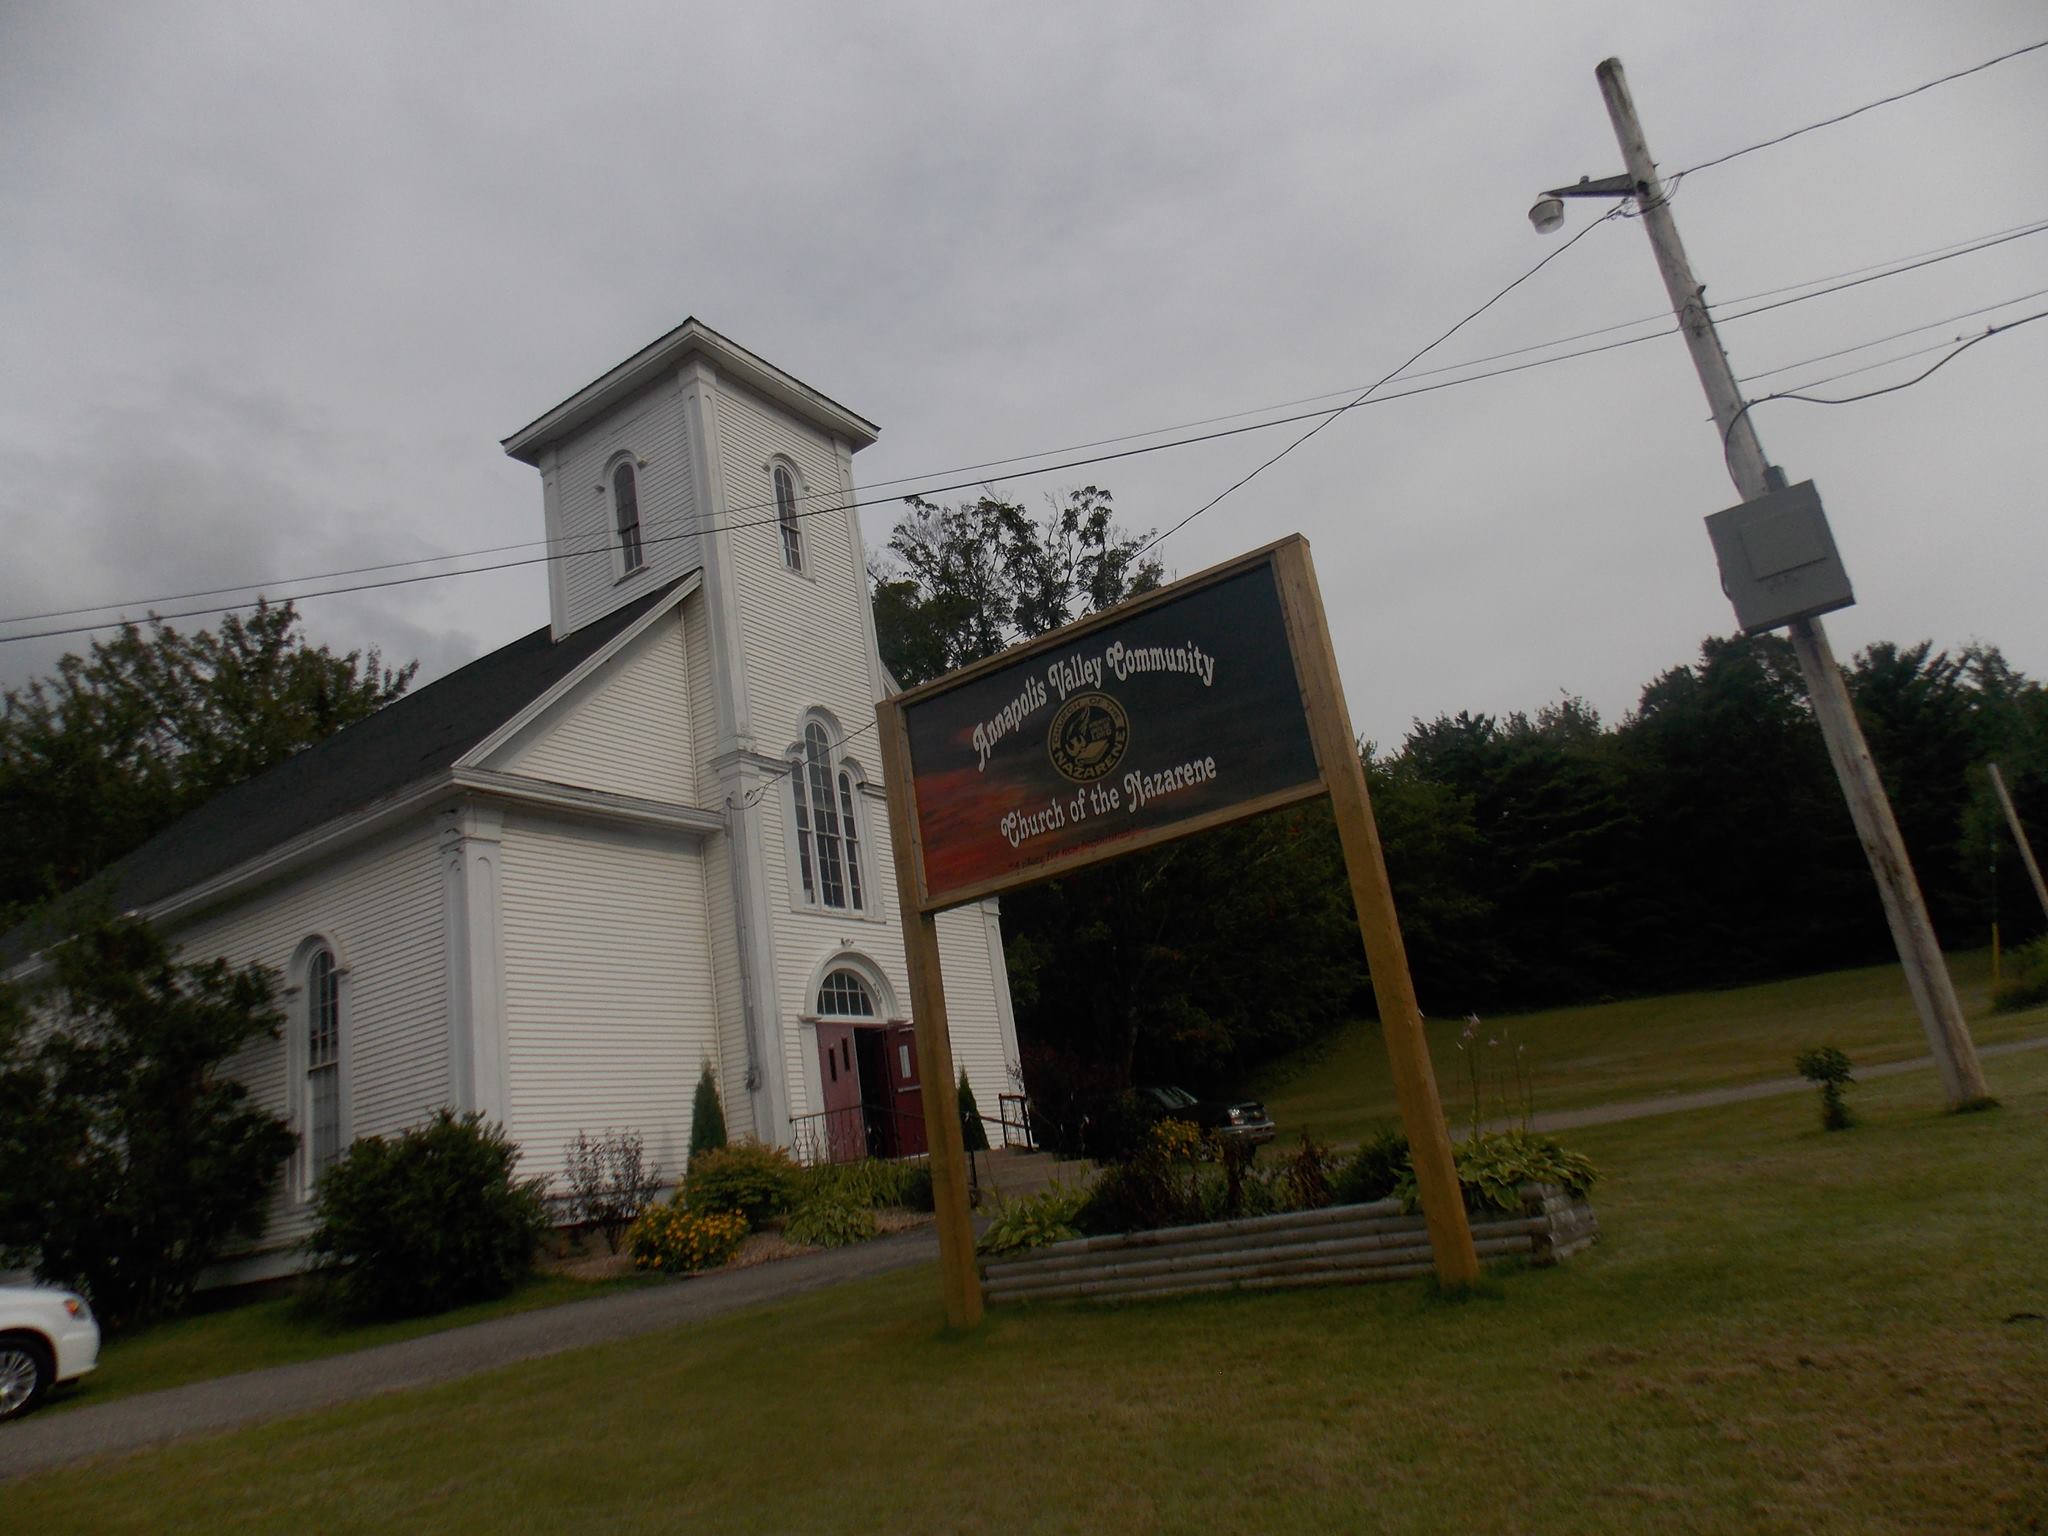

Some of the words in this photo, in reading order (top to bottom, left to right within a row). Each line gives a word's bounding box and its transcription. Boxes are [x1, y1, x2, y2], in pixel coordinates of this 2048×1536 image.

[972, 676, 1047, 771] Annapolis
[1047, 653, 1102, 701] Valley
[1105, 640, 1215, 687] Community
[1053, 702, 1082, 744] CHURCH
[1088, 697, 1105, 706] OF
[1053, 730, 1126, 779] NAZARENE
[1000, 798, 1065, 848] Church
[1069, 789, 1086, 822] of
[1090, 783, 1120, 815] the
[1123, 756, 1217, 813] Nazarene
